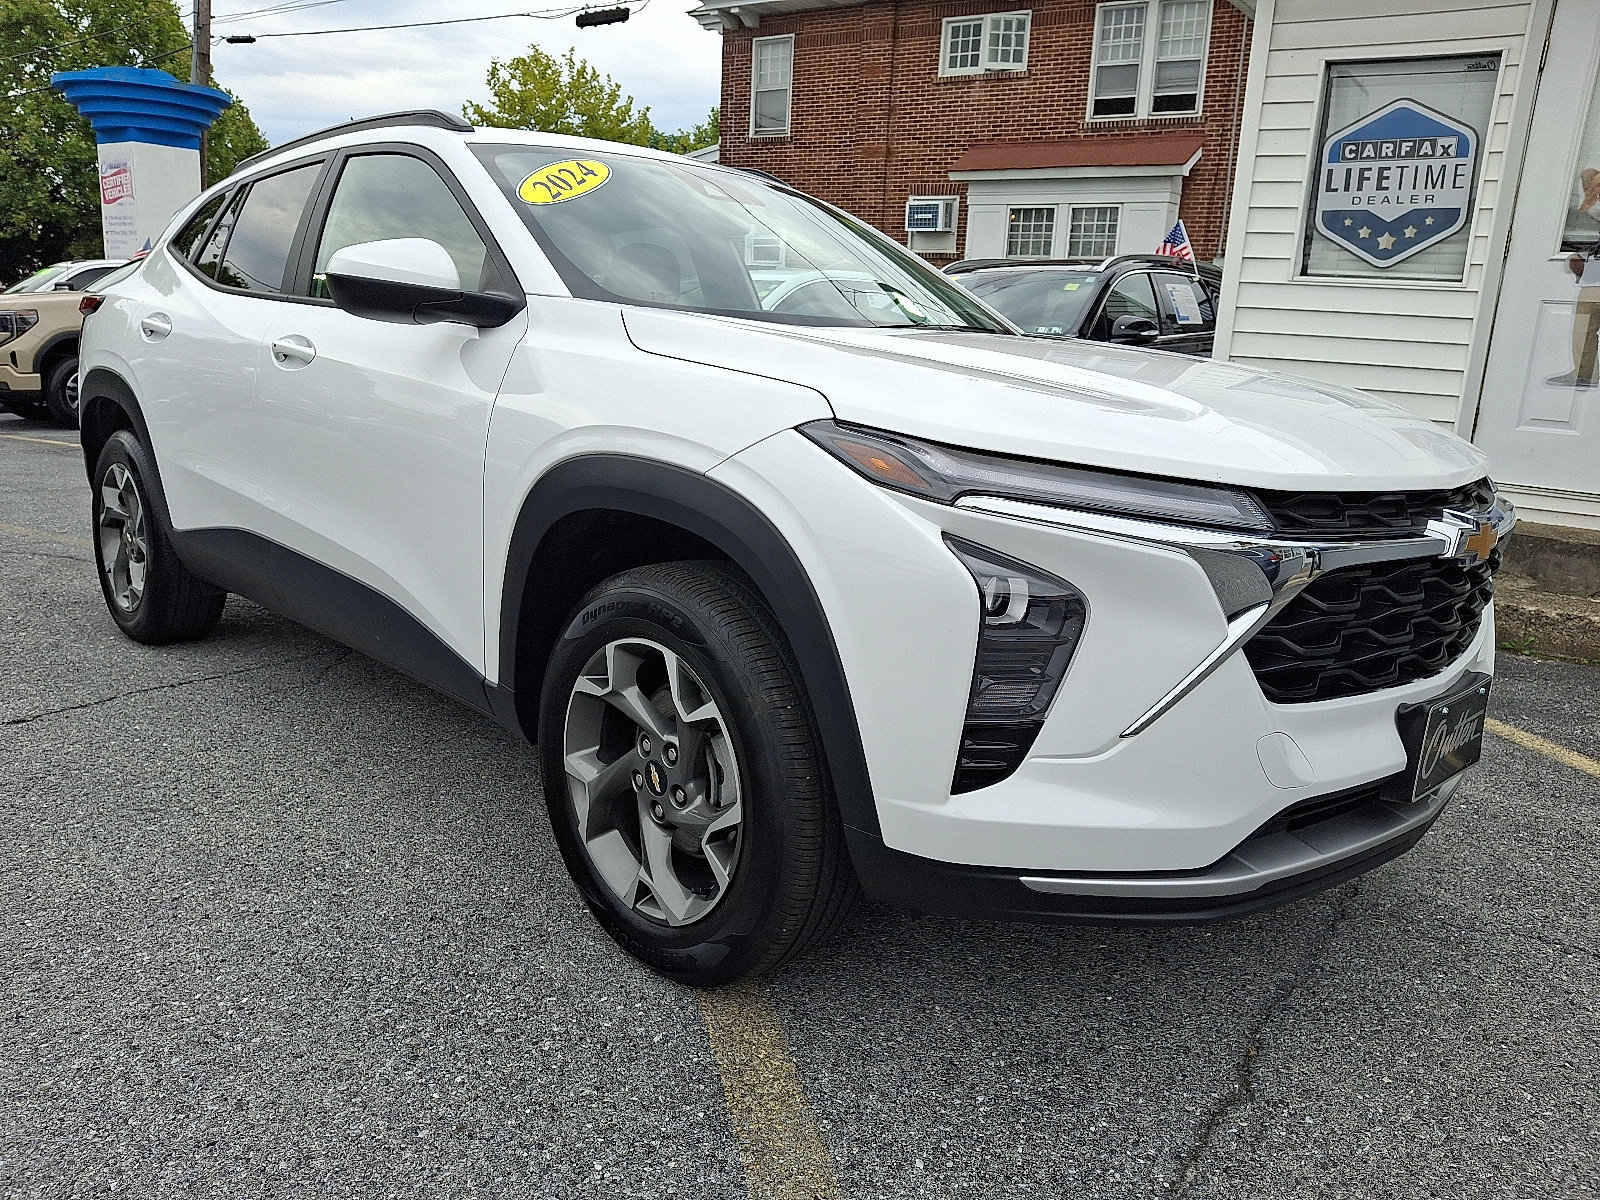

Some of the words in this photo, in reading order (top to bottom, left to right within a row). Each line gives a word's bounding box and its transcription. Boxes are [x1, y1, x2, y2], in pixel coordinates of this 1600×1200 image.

[532, 161, 598, 200] 2024
[1324, 163, 1468, 193] LIFETIME
[1351, 194, 1436, 206] DEALER
